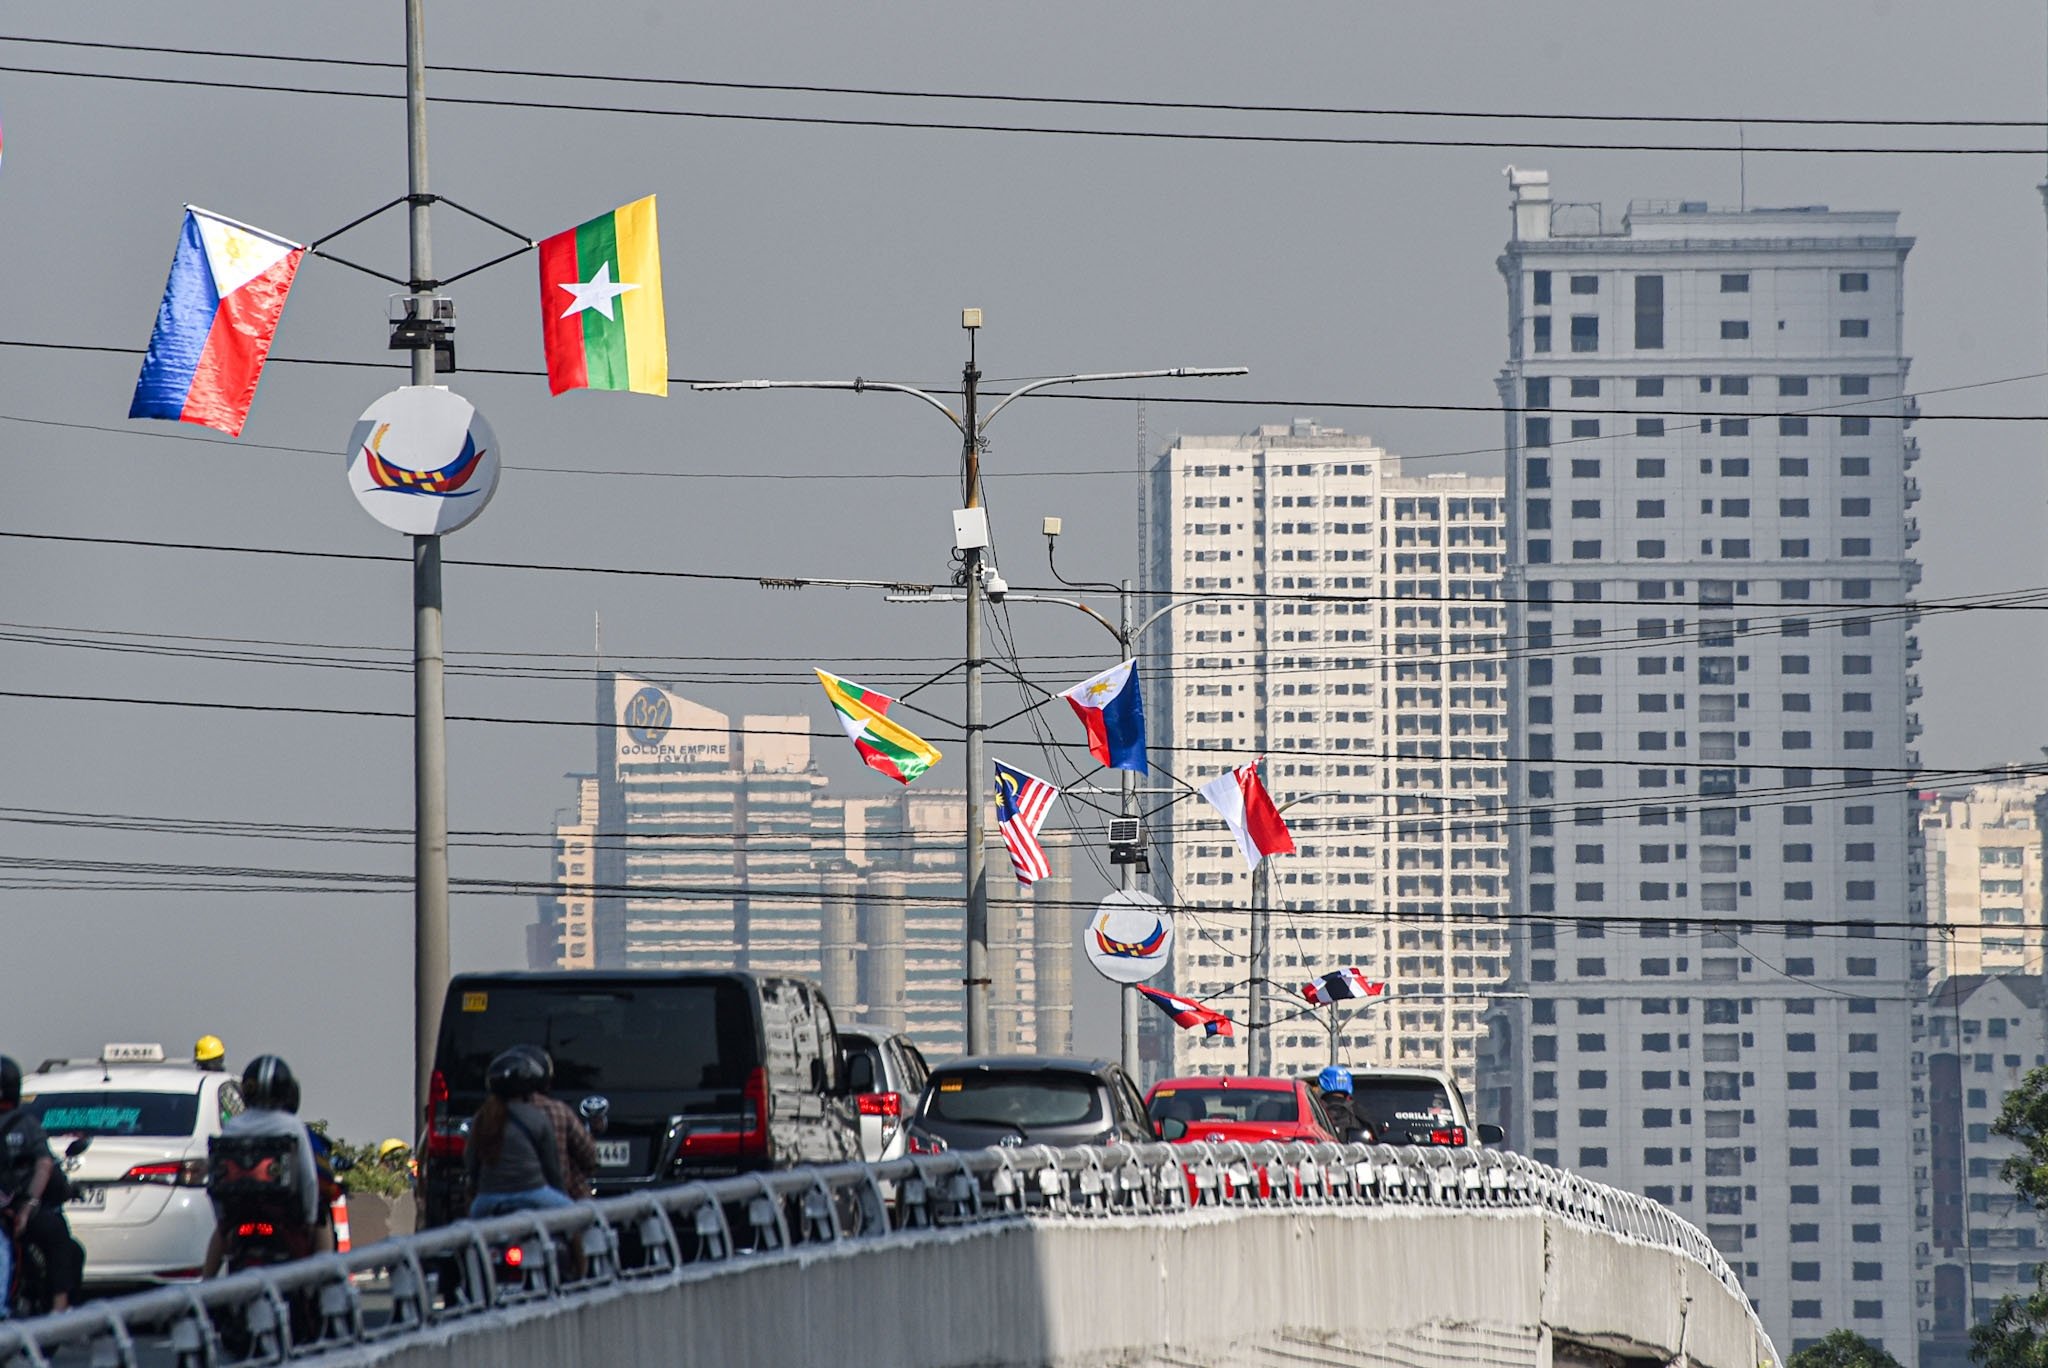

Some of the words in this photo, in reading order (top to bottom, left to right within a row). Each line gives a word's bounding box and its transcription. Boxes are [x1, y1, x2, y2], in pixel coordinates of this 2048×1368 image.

[621, 745, 676, 755] GOLDEN
[679, 744, 727, 754] EMPIRE
[1394, 1111, 1435, 1121] GORILLA
